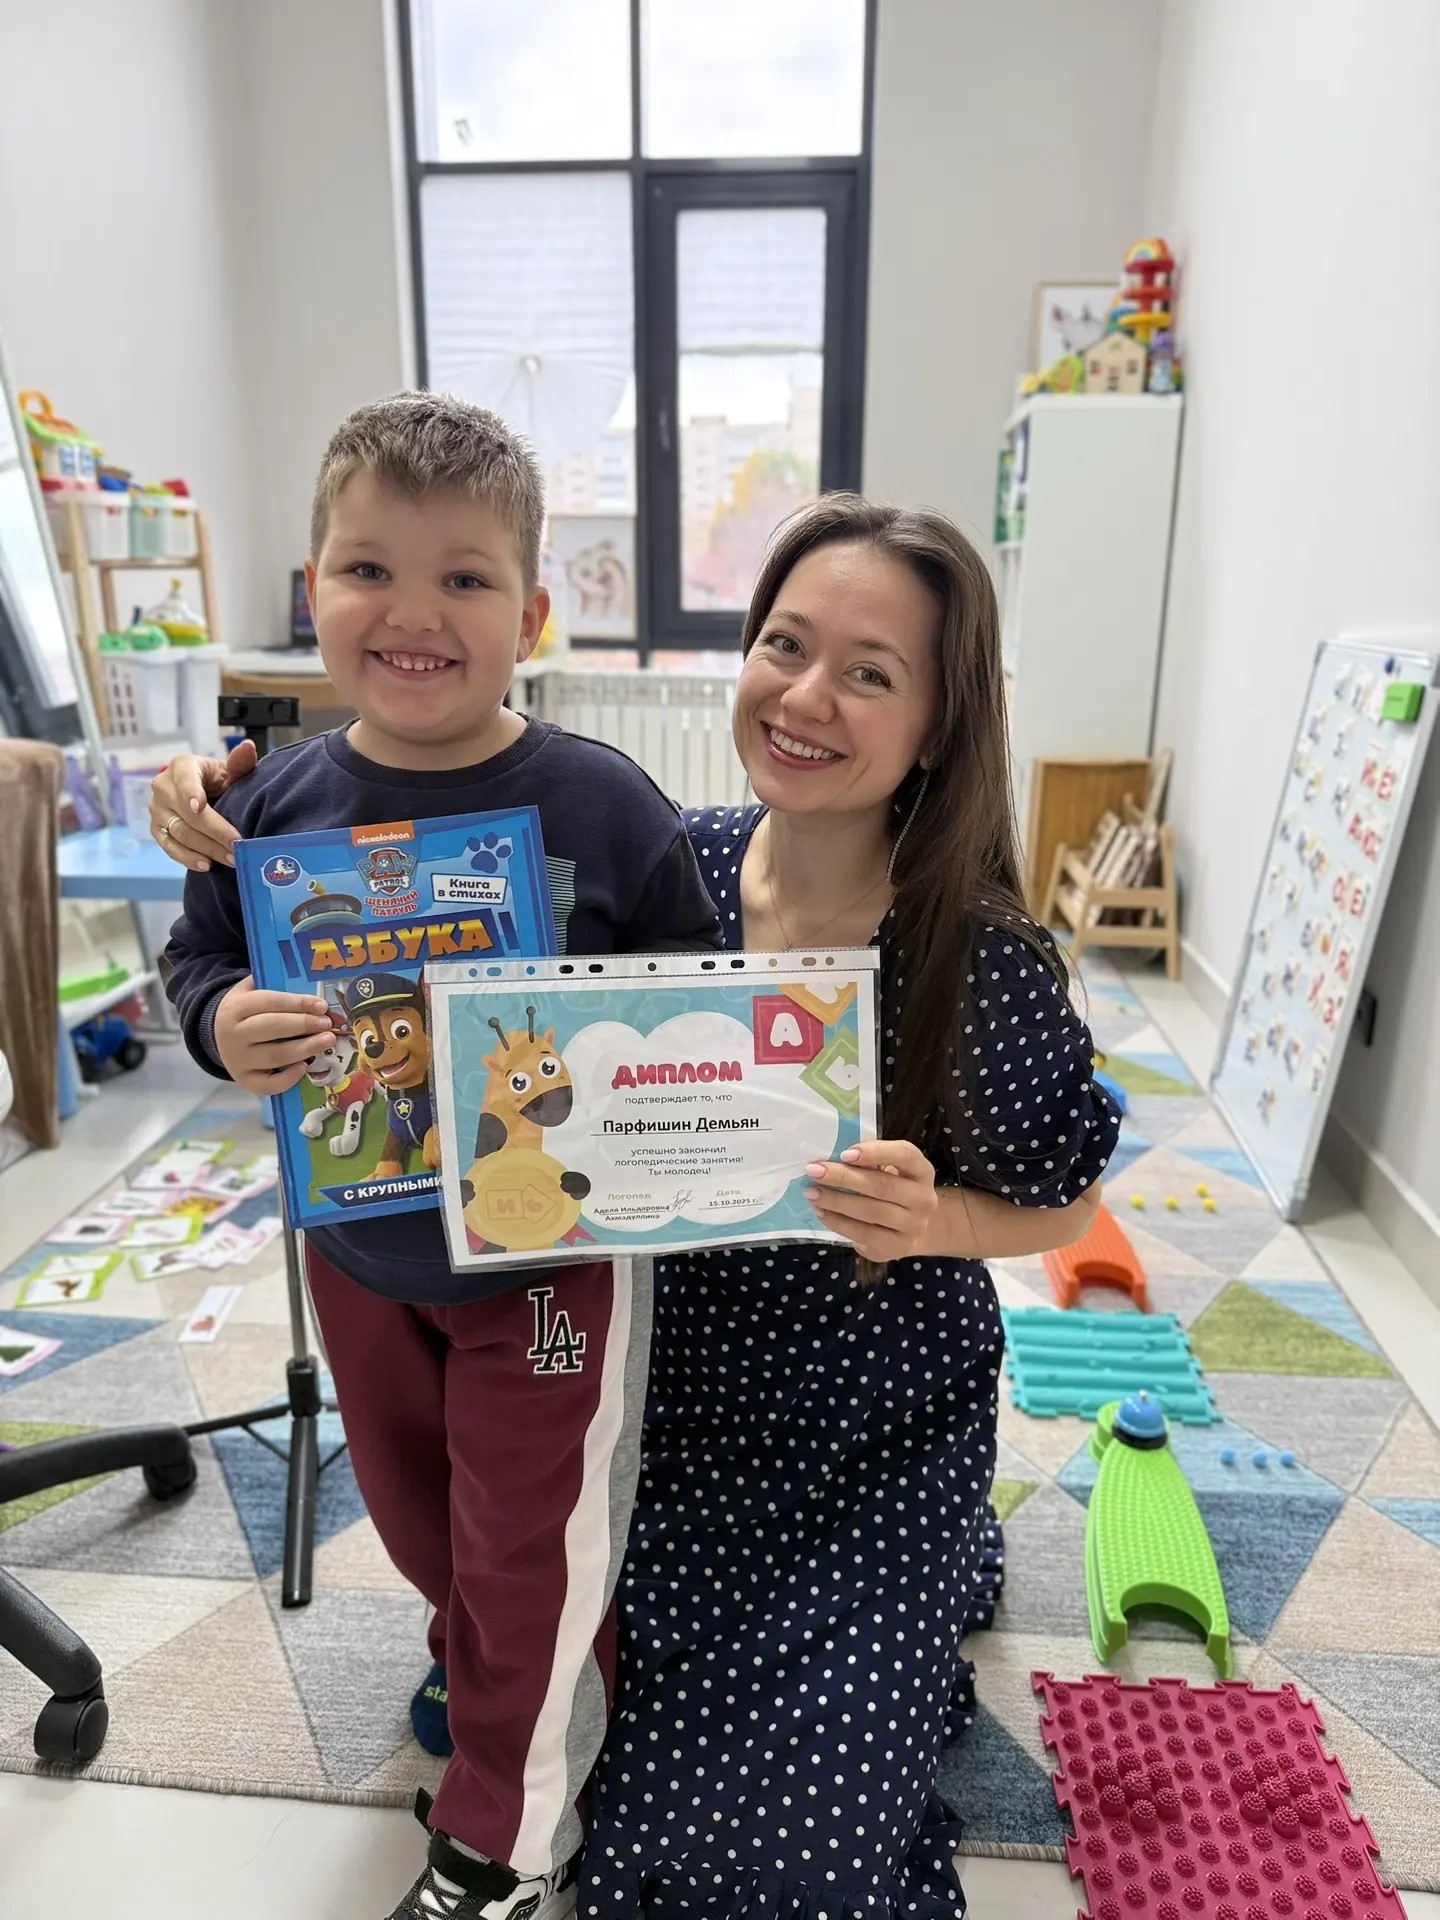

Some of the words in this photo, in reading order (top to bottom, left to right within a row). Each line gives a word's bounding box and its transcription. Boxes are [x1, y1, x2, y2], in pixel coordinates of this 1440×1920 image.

[356, 832, 410, 844] nickelodeon
[356, 854, 418, 880] PAW
[374, 877, 406, 888] PATROL
[449, 878, 490, 889] Книга
[365, 890, 419, 907] ЩЕНЯЧИЙ
[448, 890, 501, 900] стихах
[371, 903, 418, 917] ПАТРУЛЬ
[309, 917, 494, 972] АЗБУКА
[611, 1060, 743, 1090] ДИПЛОМ
[625, 1095, 698, 1105] подтверждает
[699, 1095, 713, 1103] то,
[715, 1094, 732, 1102] что
[603, 1118, 691, 1135] Парфишин
[695, 1117, 760, 1132] Демьян
[630, 1148, 676, 1157] успешно
[678, 1146, 726, 1155] закончил
[614, 1157, 699, 1167] логопедические
[701, 1156, 744, 1165] занятия!
[648, 1168, 662, 1176] Ты
[664, 1167, 711, 1176] молодец!
[709, 1198, 751, 1207] 15.10.2025
[593, 1207, 619, 1215] Аделя
[527, 1286, 587, 1375] LA
